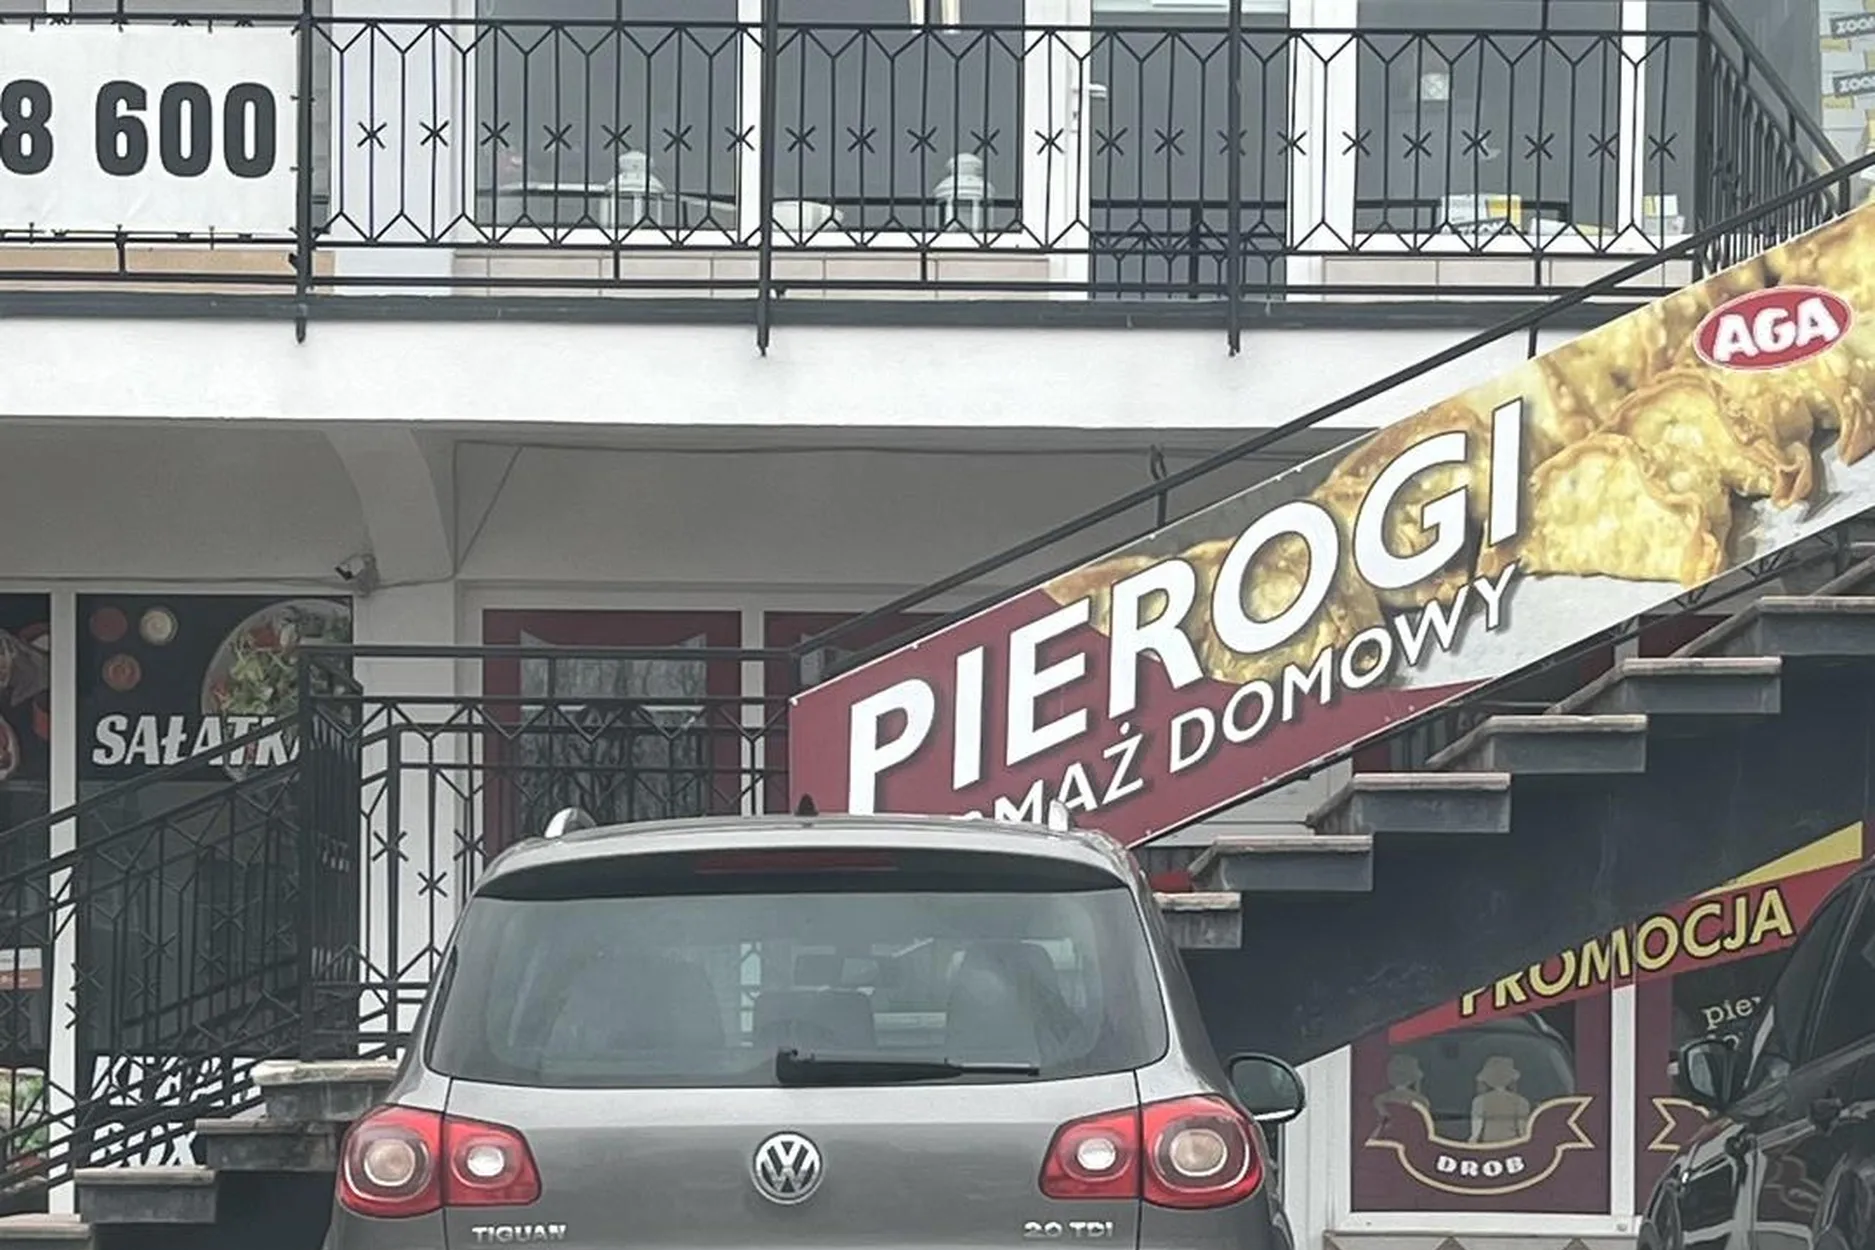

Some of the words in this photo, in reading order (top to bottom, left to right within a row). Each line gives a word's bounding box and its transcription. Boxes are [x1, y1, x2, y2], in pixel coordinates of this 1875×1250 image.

[0, 79, 53, 175] 8
[95, 80, 276, 178] 600
[1711, 298, 1839, 363] AGA
[848, 397, 1524, 815] PIEROGI
[963, 721, 1145, 824] MAŻ
[1168, 561, 1521, 774] DOMOWY
[92, 714, 320, 766] SAŁATK
[1702, 996, 1761, 1030] pie
[1436, 1154, 1525, 1177] DROB
[471, 1224, 567, 1243] TIGUAN
[1068, 1221, 1113, 1238] TDI
